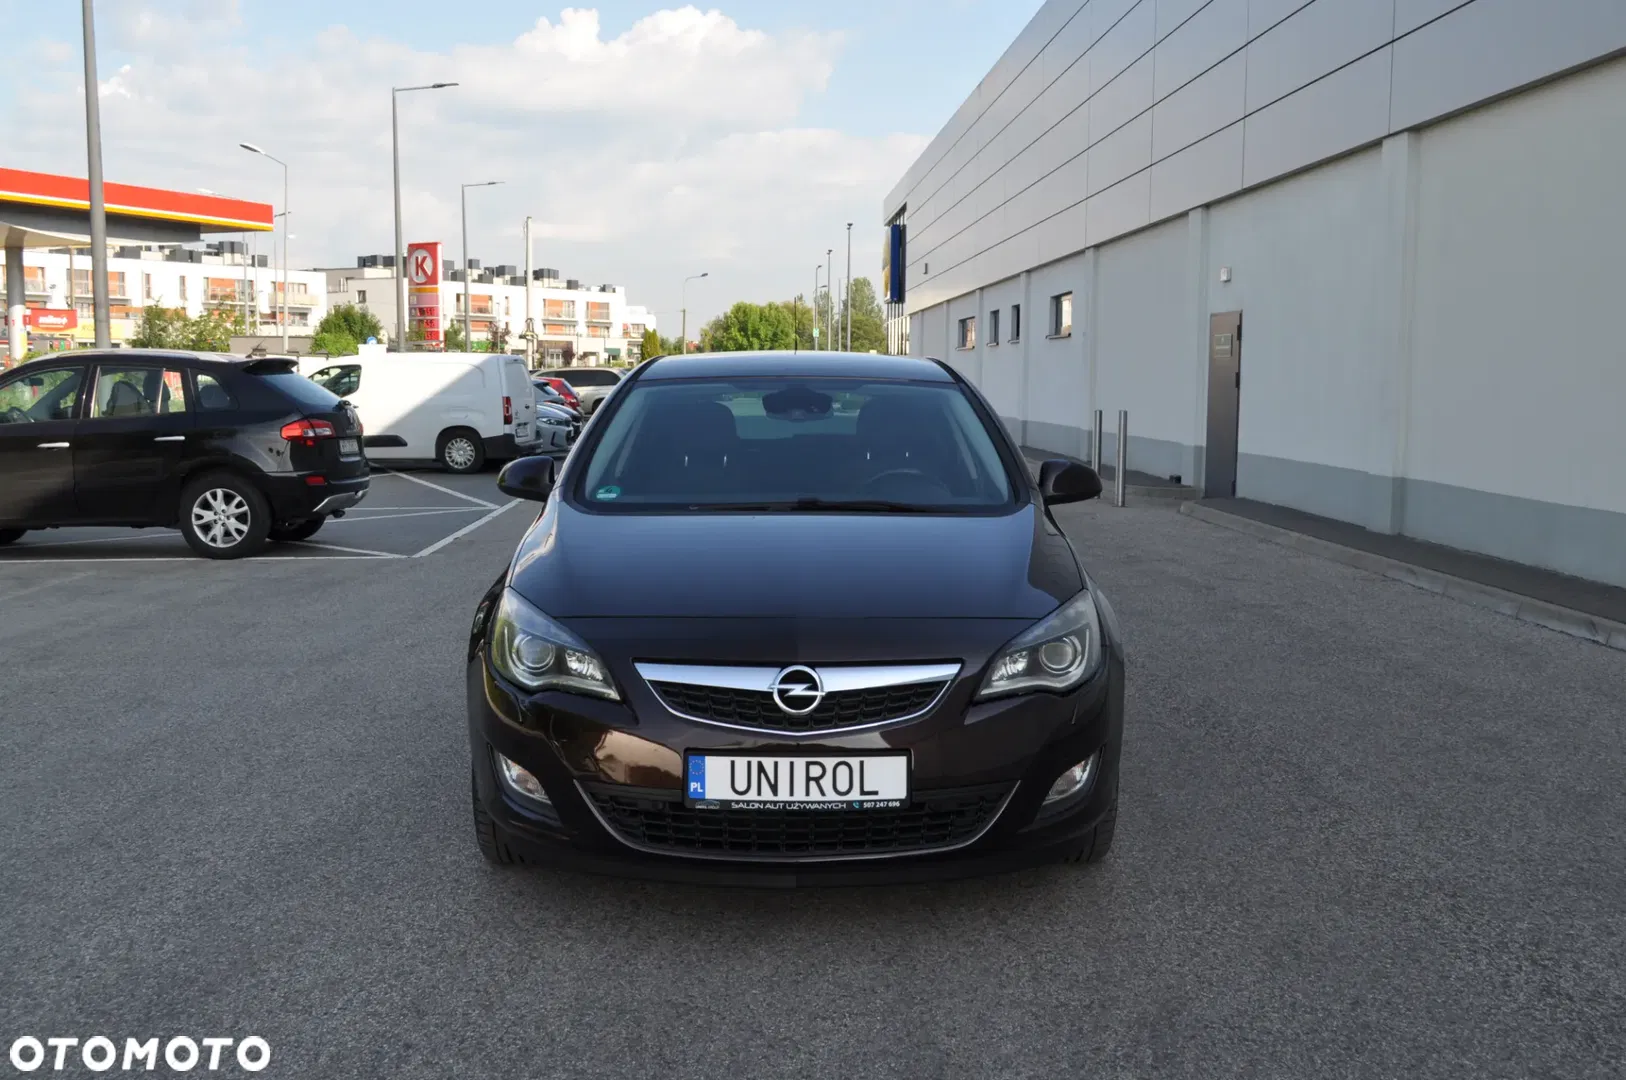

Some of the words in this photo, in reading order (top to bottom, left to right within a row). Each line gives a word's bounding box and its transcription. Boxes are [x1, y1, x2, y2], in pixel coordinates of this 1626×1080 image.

[416, 256, 431, 276] K
[730, 760, 879, 797] UNIROL
[690, 782, 703, 793] PL
[786, 801, 847, 810] UŻYWANYCH
